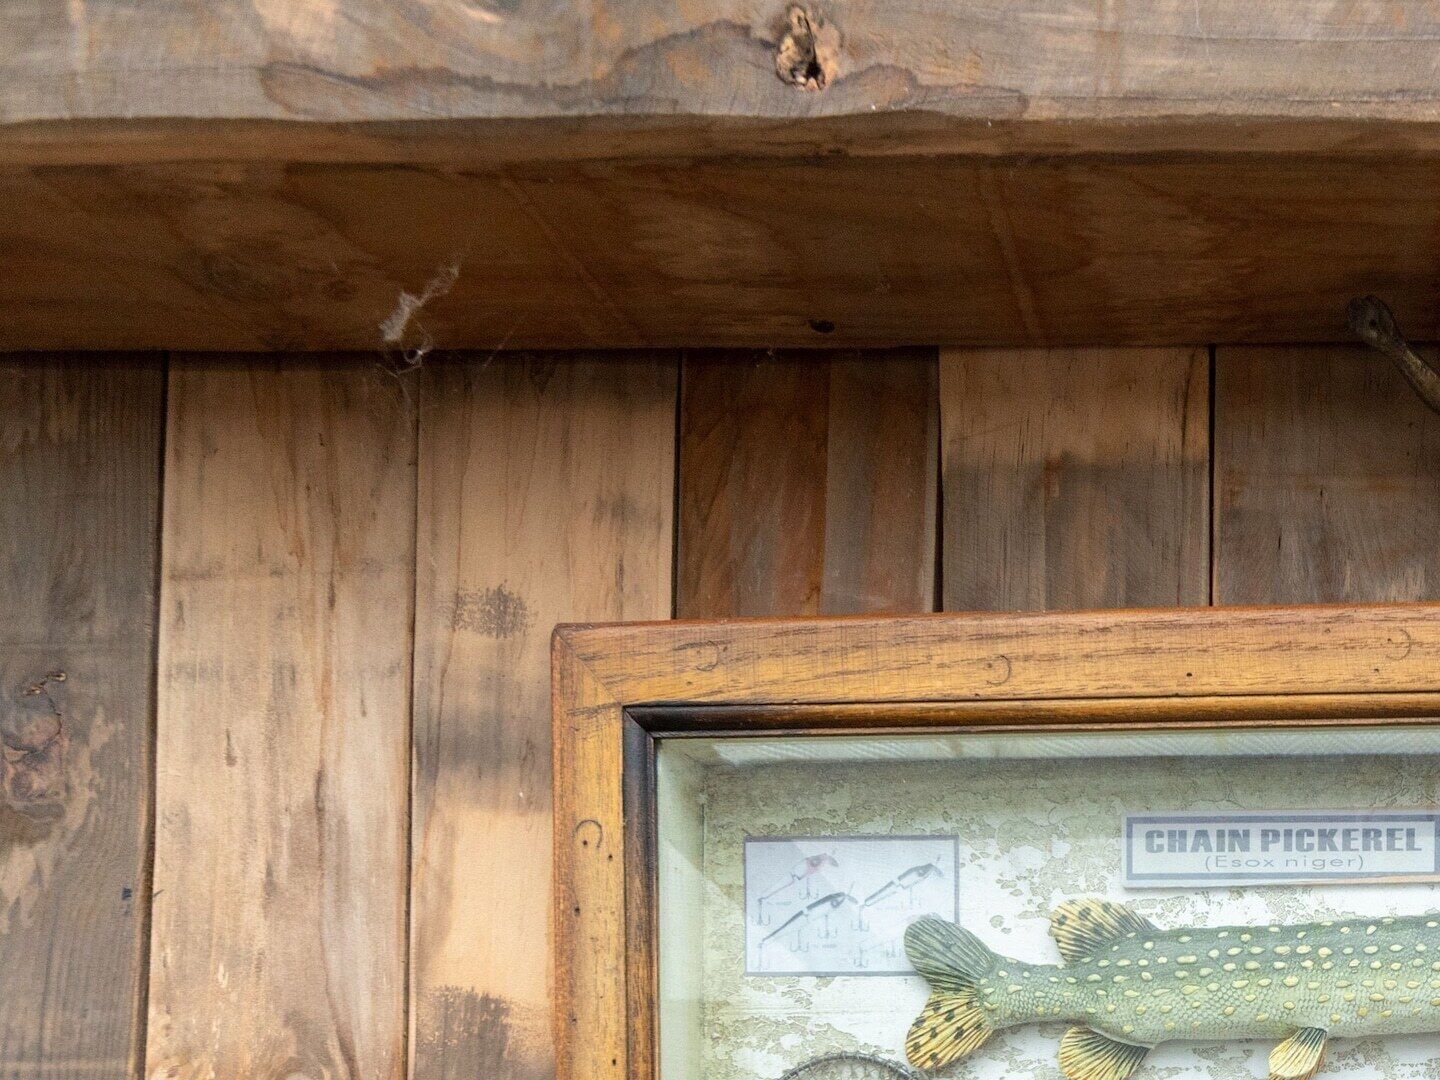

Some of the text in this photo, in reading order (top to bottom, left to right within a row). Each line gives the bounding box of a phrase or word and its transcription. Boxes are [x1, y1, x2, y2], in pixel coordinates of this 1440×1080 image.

[1144, 827, 1423, 854] CHAIN PICKEREL
[1204, 854, 1365, 872] (Esox niger)
